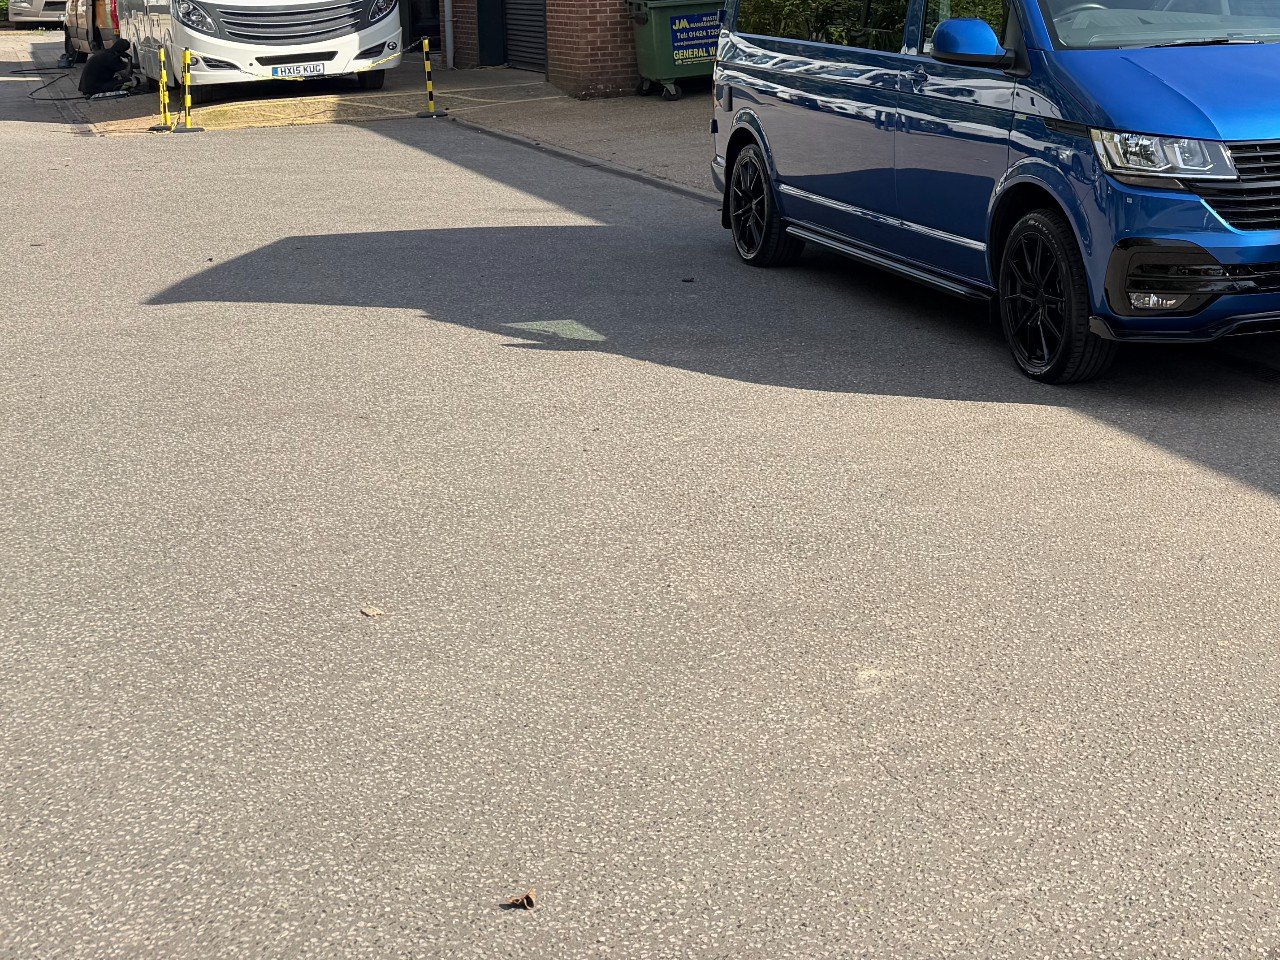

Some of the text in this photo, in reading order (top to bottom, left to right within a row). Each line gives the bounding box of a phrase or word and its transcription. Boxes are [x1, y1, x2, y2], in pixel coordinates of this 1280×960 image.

[672, 19, 690, 30] JM
[688, 30, 707, 38] 01424
[673, 48, 708, 60] GENERAL
